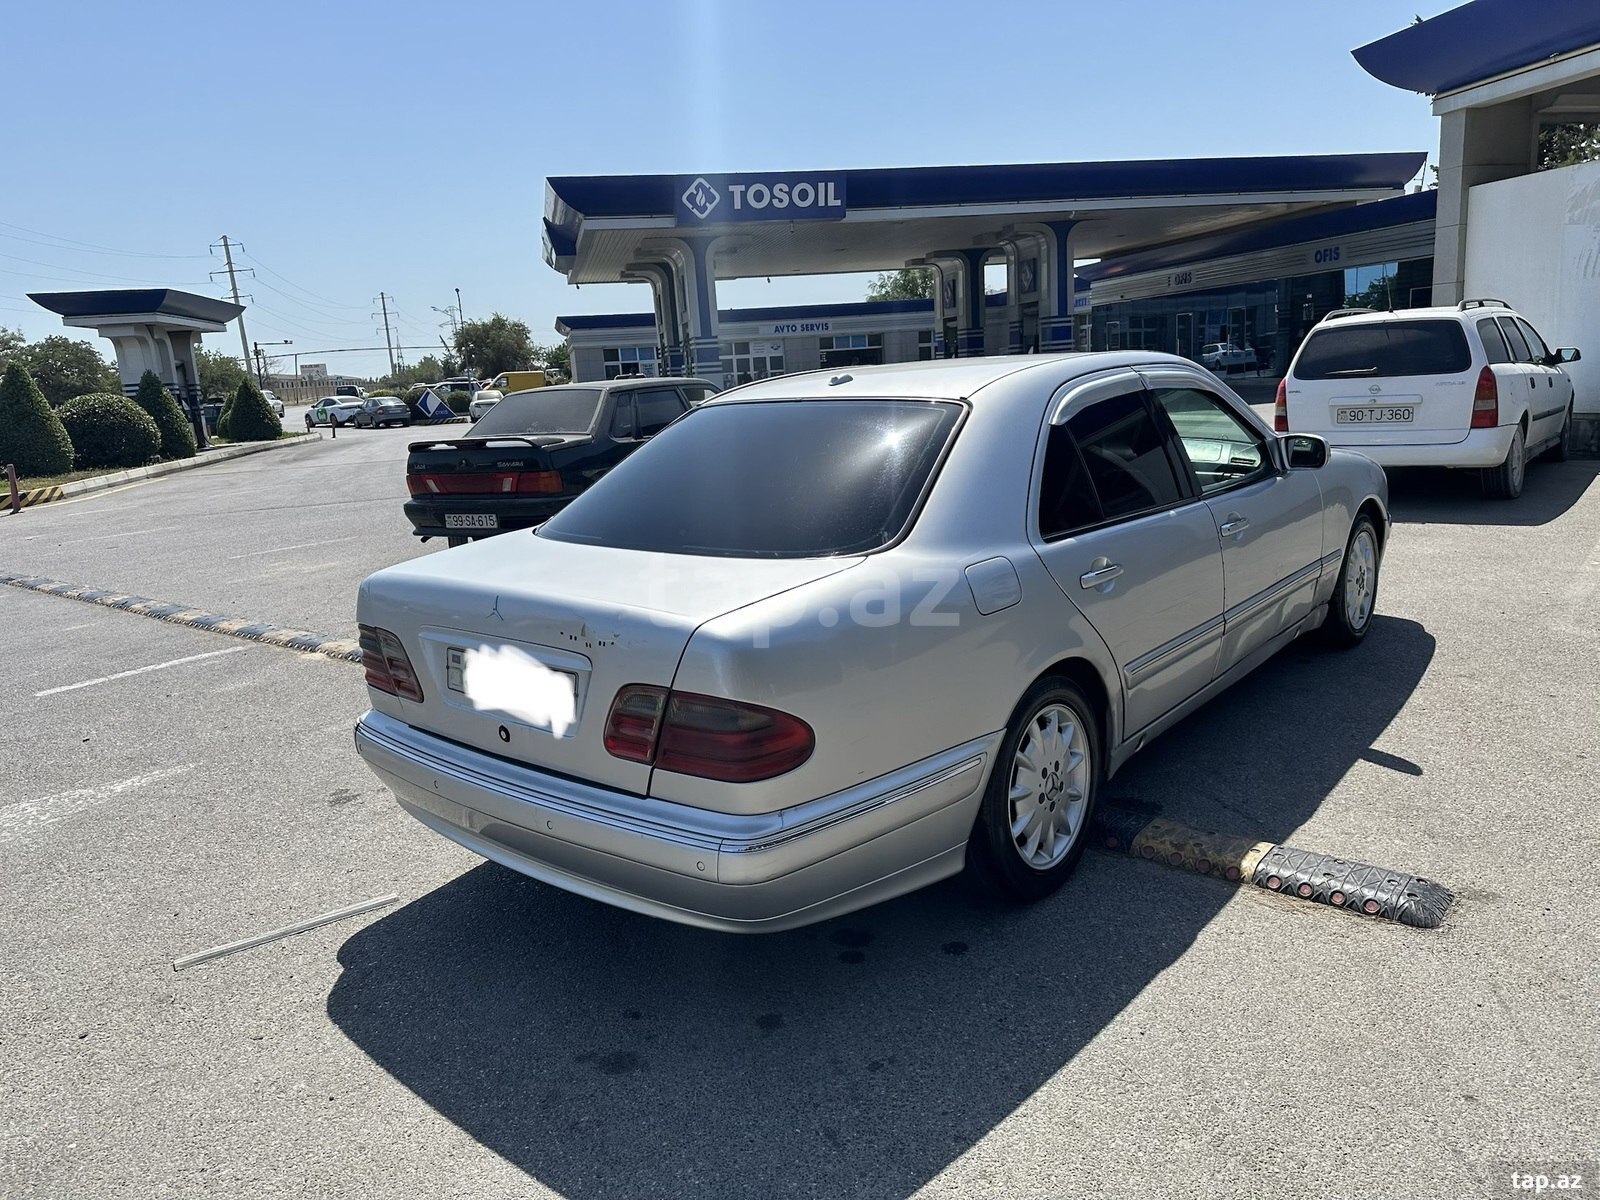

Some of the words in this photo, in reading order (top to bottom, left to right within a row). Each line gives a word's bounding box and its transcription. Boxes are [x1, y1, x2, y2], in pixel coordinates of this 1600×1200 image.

[728, 182, 842, 210] TOSOIL
[1314, 246, 1340, 263] OFIS
[774, 324, 797, 334] AVTO
[800, 322, 829, 332] SERVIS
